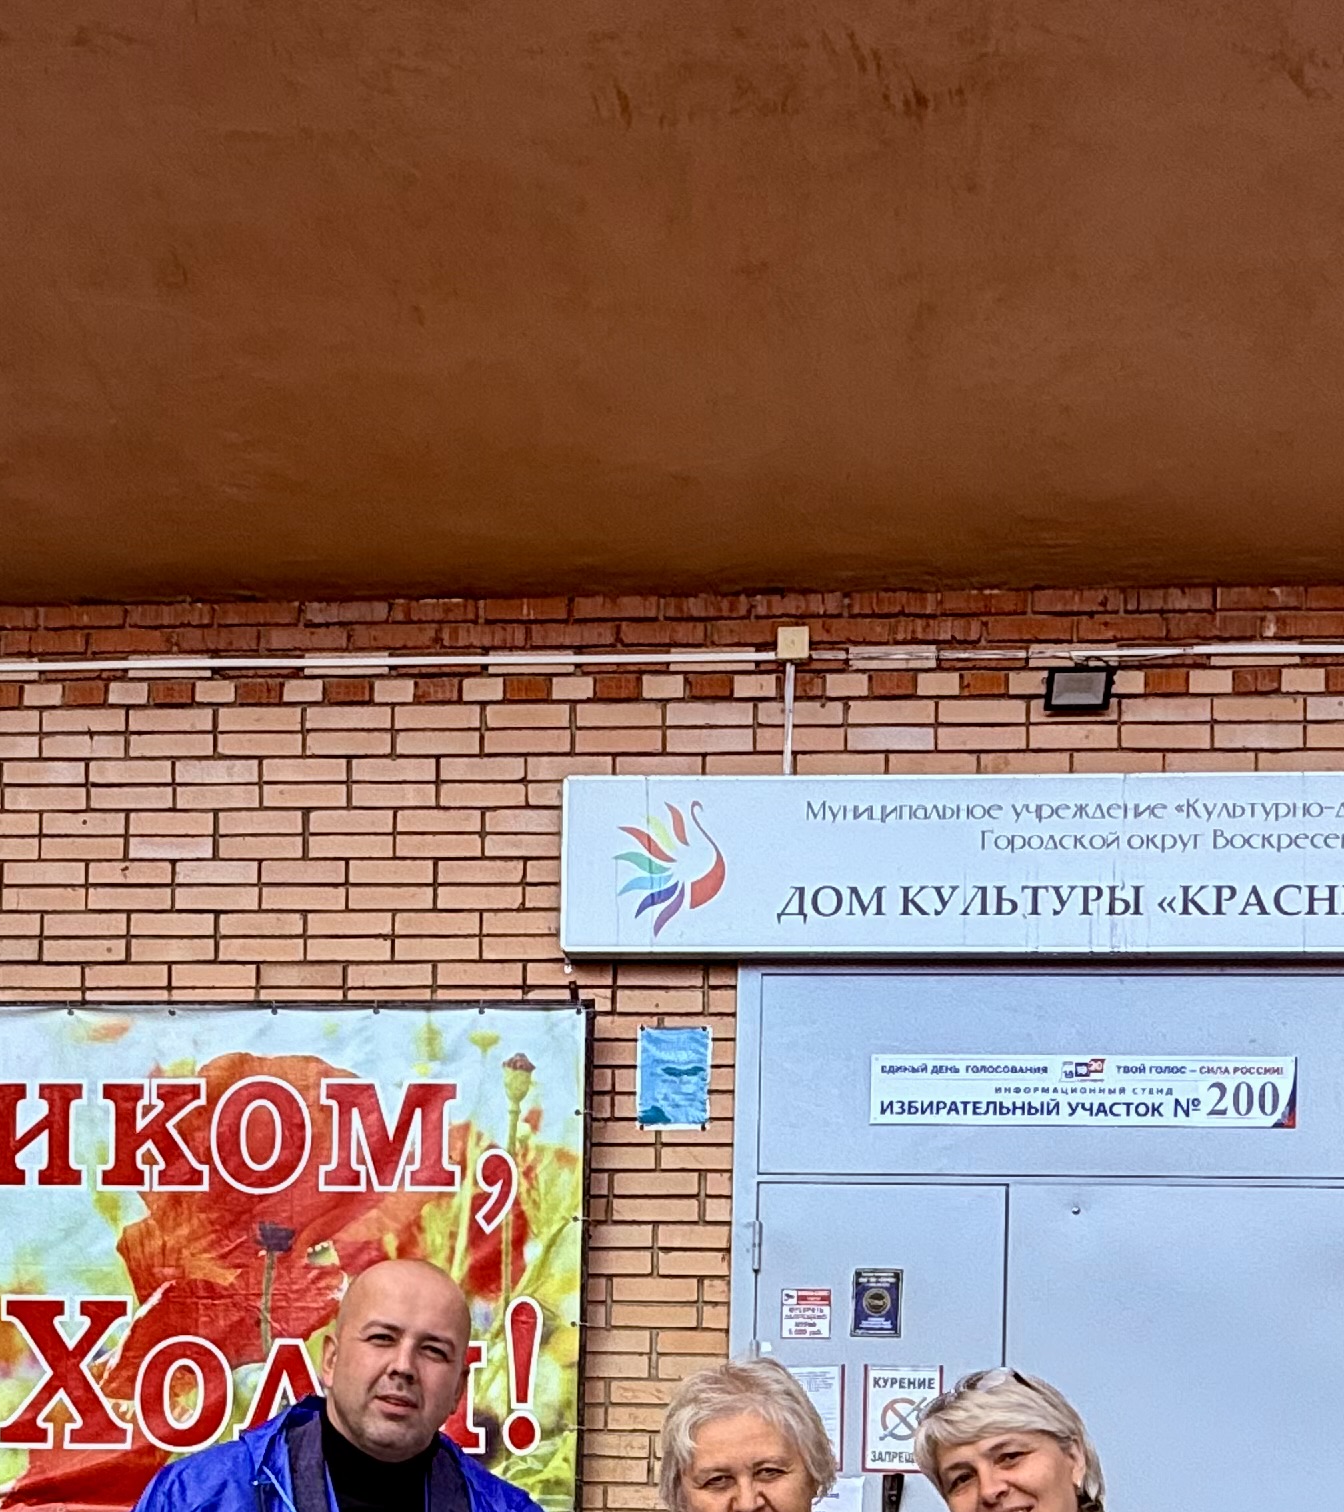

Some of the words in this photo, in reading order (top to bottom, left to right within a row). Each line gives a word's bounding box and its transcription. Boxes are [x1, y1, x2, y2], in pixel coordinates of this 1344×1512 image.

[805, 799, 1004, 823] Муниципальное
[1010, 801, 1169, 824] учреждение
[980, 829, 1121, 853] Городской
[1125, 833, 1204, 853] округ
[777, 884, 887, 925] ДОМ
[898, 883, 1145, 917] КУЛЬТУРЫ
[965, 1065, 1049, 1074] ГОЛОСОВАНИЯ
[1116, 1064, 1146, 1074] ТВОЙ
[1149, 1065, 1187, 1075] ГОЛОС
[1199, 1066, 1230, 1075] СИЛА
[994, 1086, 1126, 1096] ИНФОРМАЦИОННЫЙ
[880, 1098, 1060, 1116] ИЗБИРАТЕЛЬНЫЙ
[1067, 1101, 1164, 1118] УЧАСТОК
[1173, 1098, 1202, 1118] №
[1206, 1080, 1280, 1117] 200
[872, 1376, 936, 1390] КУРЕНИЕ
[870, 1451, 915, 1465] ЗАПРЕЩ
